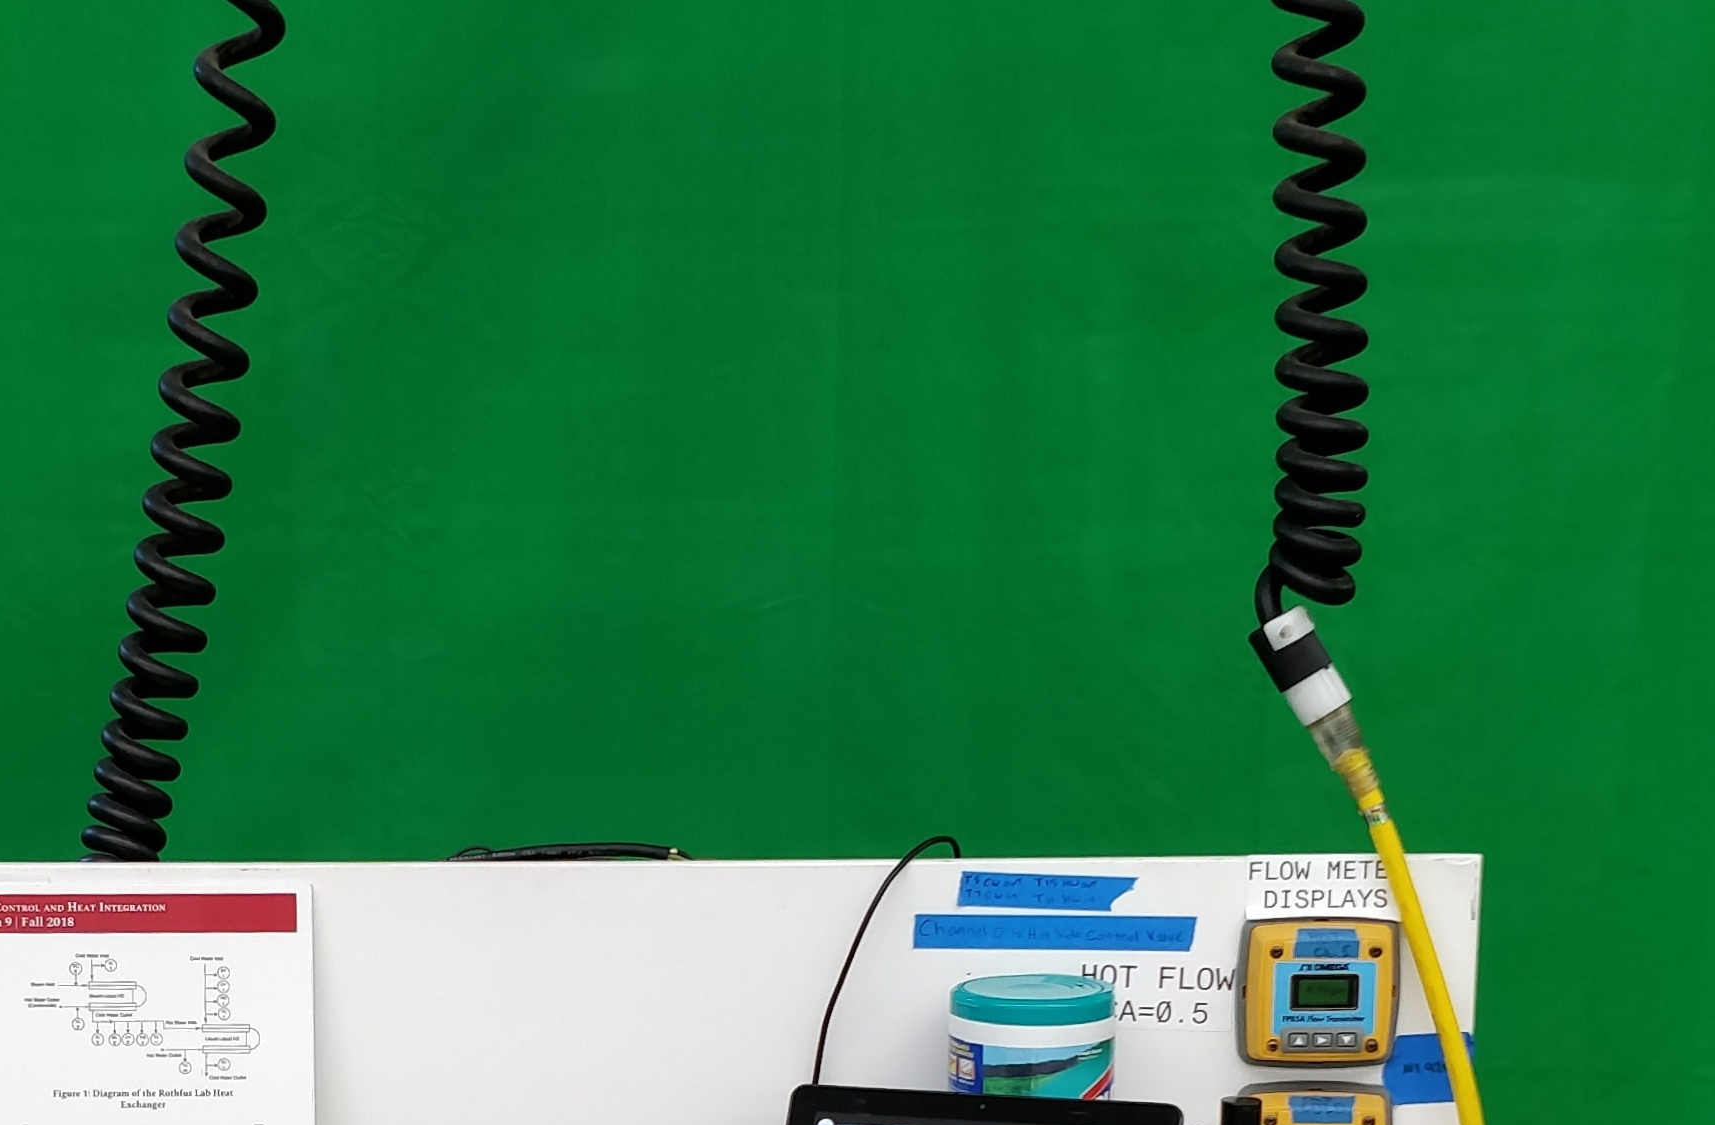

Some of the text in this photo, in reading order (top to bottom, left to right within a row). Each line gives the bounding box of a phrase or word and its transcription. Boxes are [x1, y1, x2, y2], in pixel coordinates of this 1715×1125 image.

[1248, 860, 1388, 881] FLOW METE
[1264, 889, 1388, 909] DISPLAYS
[5, 917, 12, 926] 9
[22, 916, 43, 927] Fall
[46, 917, 74, 927] 2018
[1086, 929, 1140, 942] Control
[1081, 964, 1236, 991] HOT FLOW
[1115, 1000, 1208, 1025] A=0.5
[53, 1089, 80, 1099] Figure
[84, 1089, 90, 1097] 1:
[93, 1089, 129, 1099] Diagram
[143, 1089, 155, 1097] the
[159, 1088, 192, 1097] Rothfus
[195, 1089, 211, 1097] Lab
[213, 1089, 233, 1097] Heat
[121, 1100, 165, 1110] Exchanger
